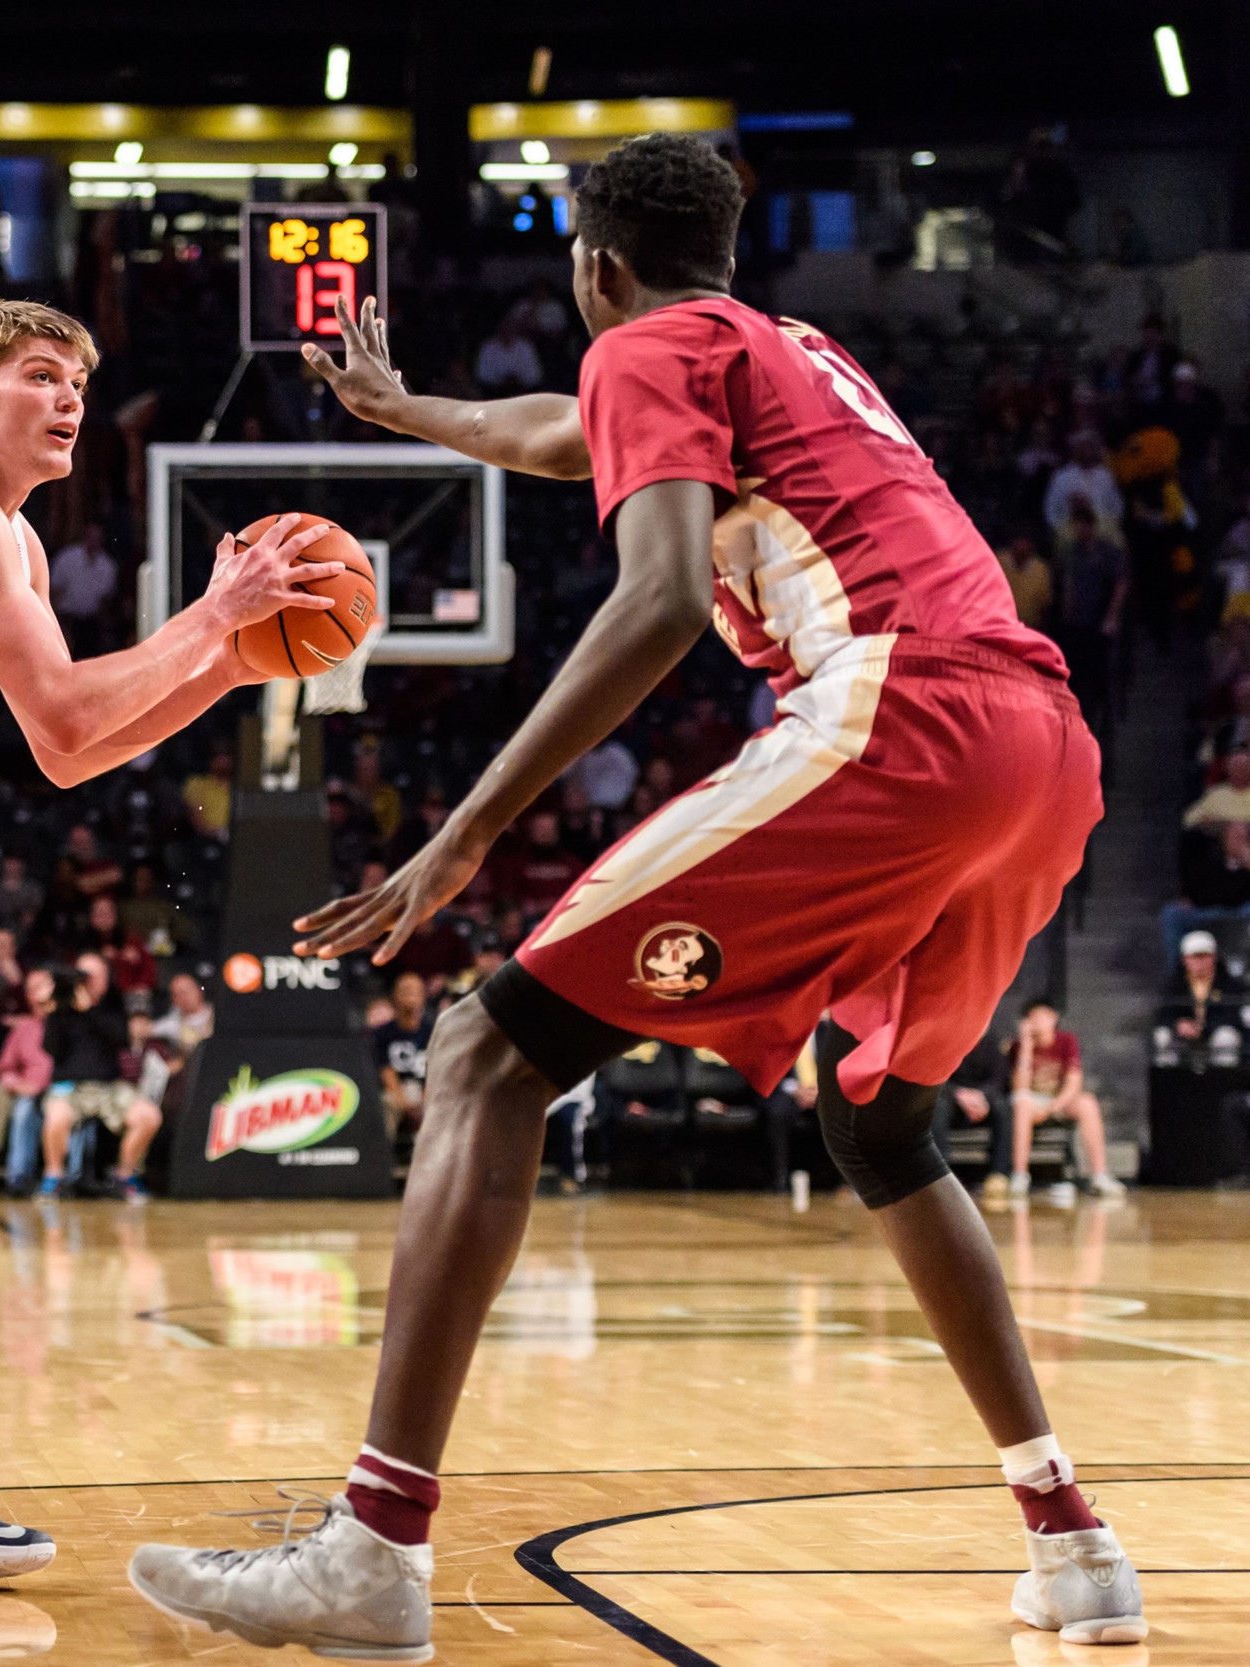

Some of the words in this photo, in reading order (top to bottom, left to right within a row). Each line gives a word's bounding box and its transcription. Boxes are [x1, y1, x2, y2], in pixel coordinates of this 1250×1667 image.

[269, 219, 369, 263] 12:16
[296, 261, 356, 334] 13
[264, 956, 341, 990] PNC
